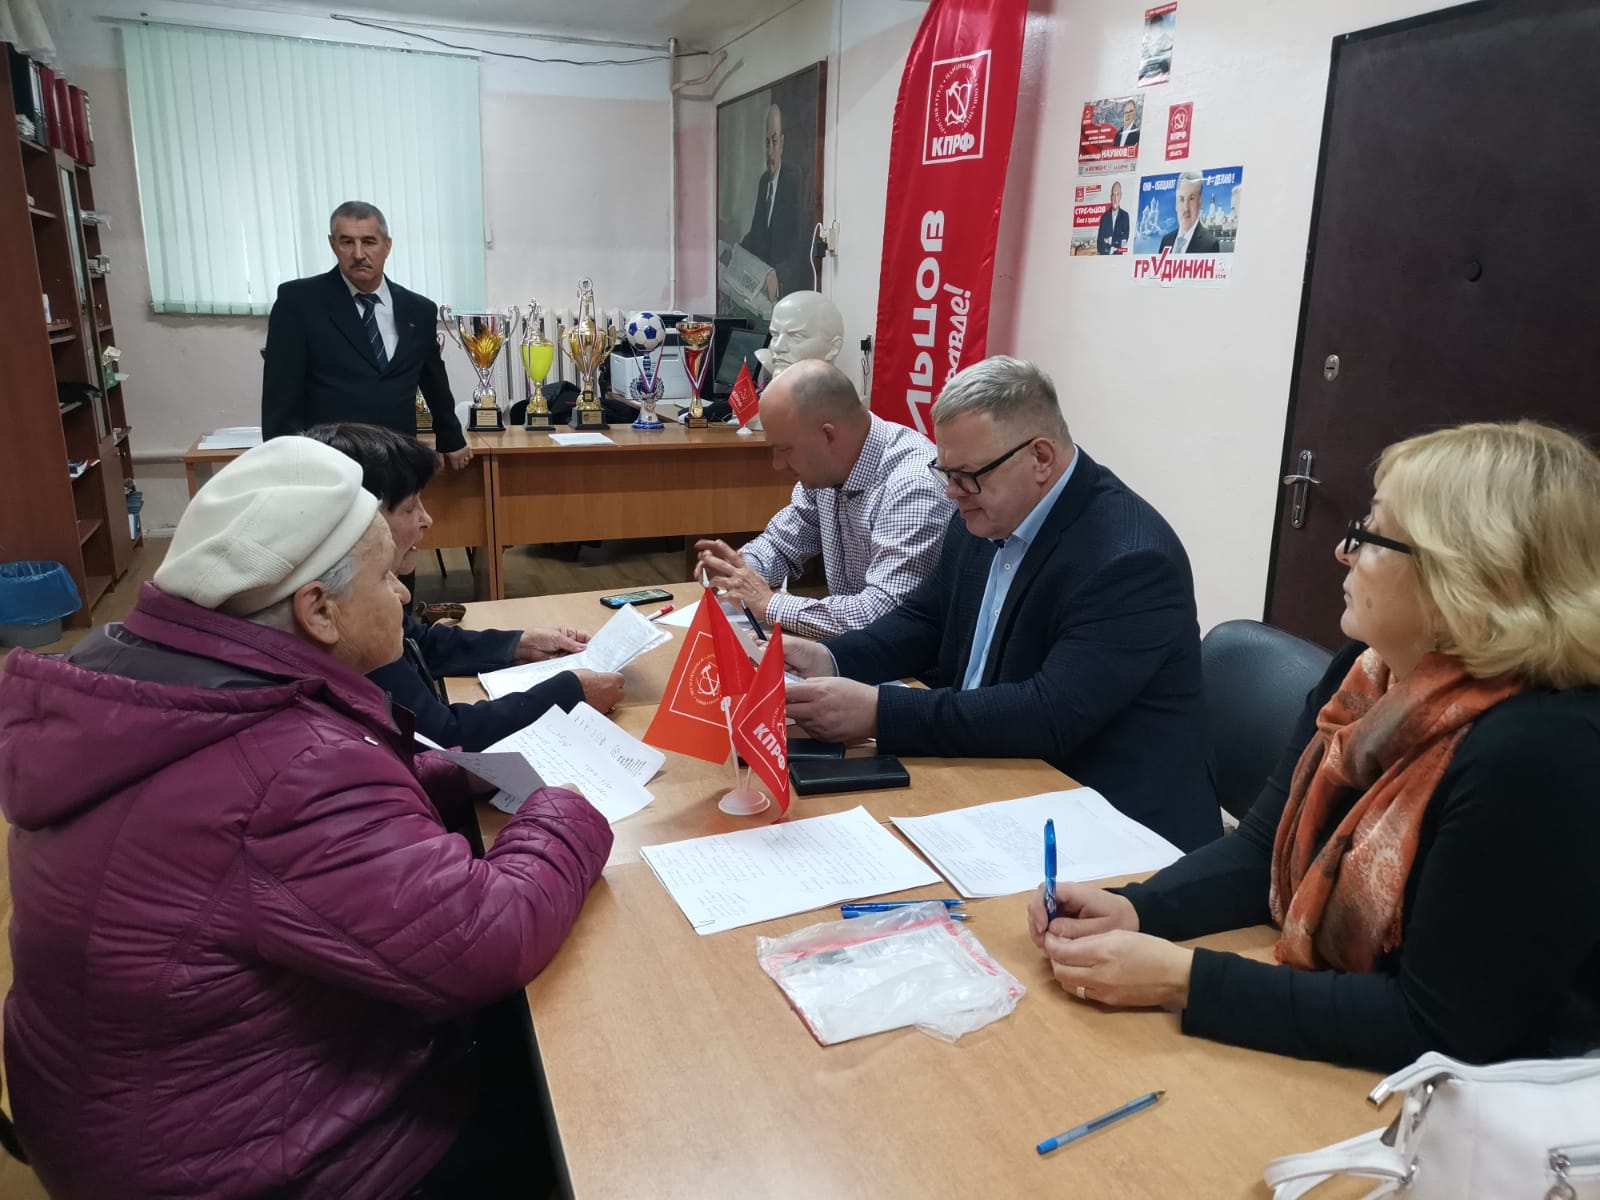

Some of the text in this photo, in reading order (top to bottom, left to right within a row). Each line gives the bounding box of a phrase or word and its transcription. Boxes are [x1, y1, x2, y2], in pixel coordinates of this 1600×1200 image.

[932, 133, 975, 157] КПРФ
[1133, 246, 1216, 282] ГРУДИНИН
[752, 722, 786, 771] КПРФ
